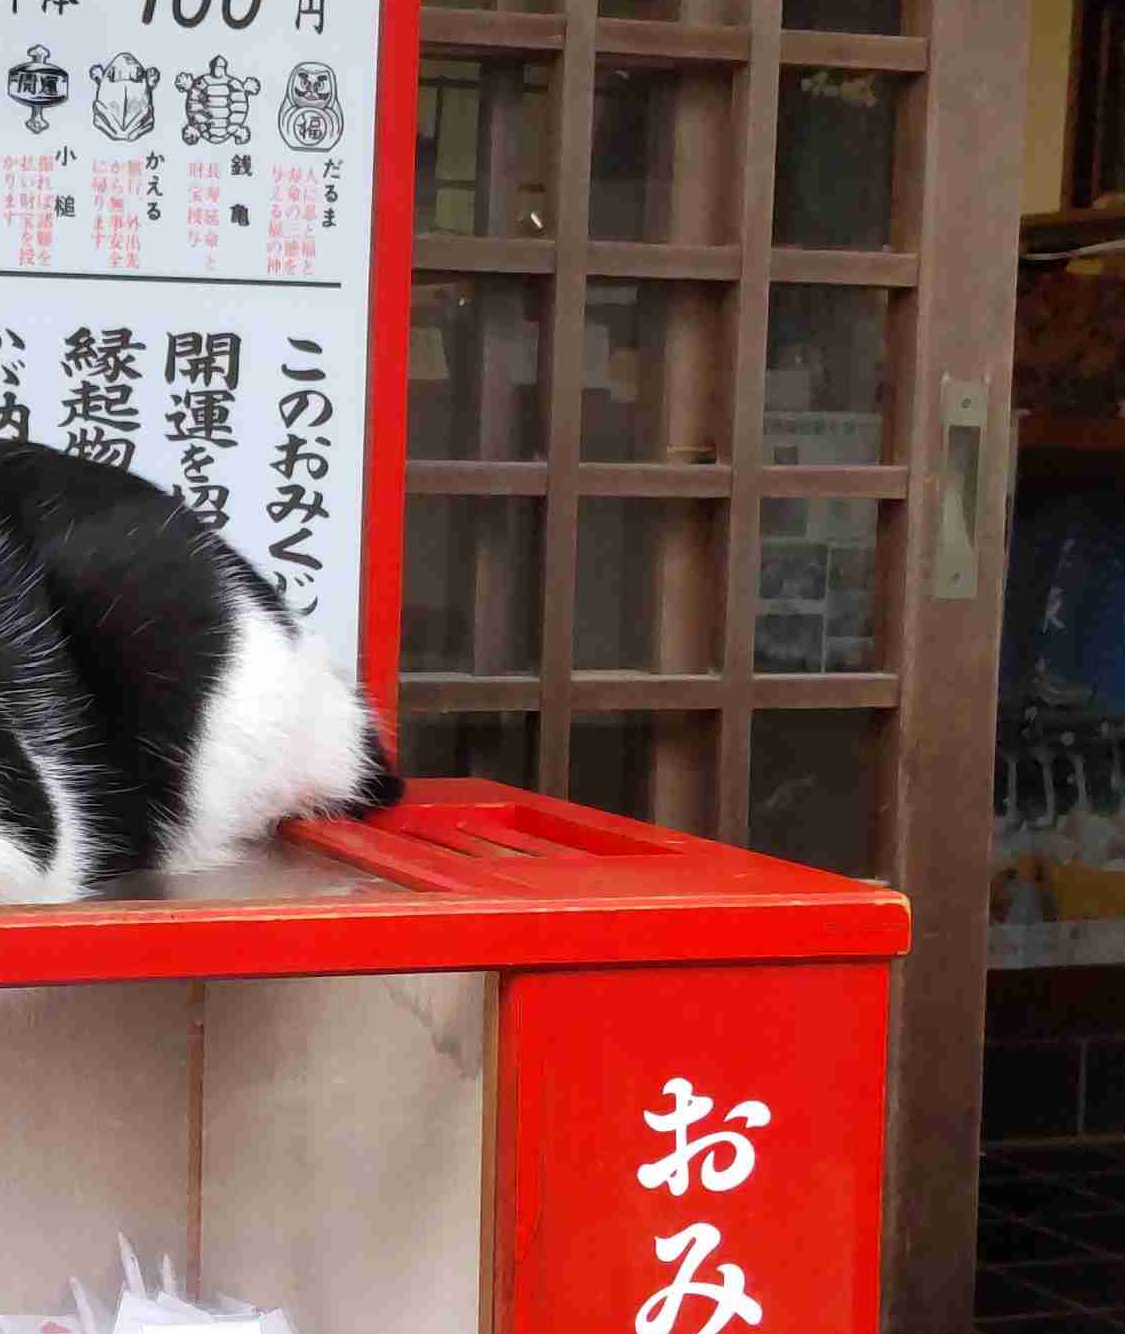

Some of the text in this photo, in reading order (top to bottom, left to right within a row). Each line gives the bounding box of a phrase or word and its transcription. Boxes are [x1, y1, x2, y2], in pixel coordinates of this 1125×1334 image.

[297, 114, 323, 141] 福
[145, 150, 165, 221] かえる
[322, 158, 344, 228] だるま
